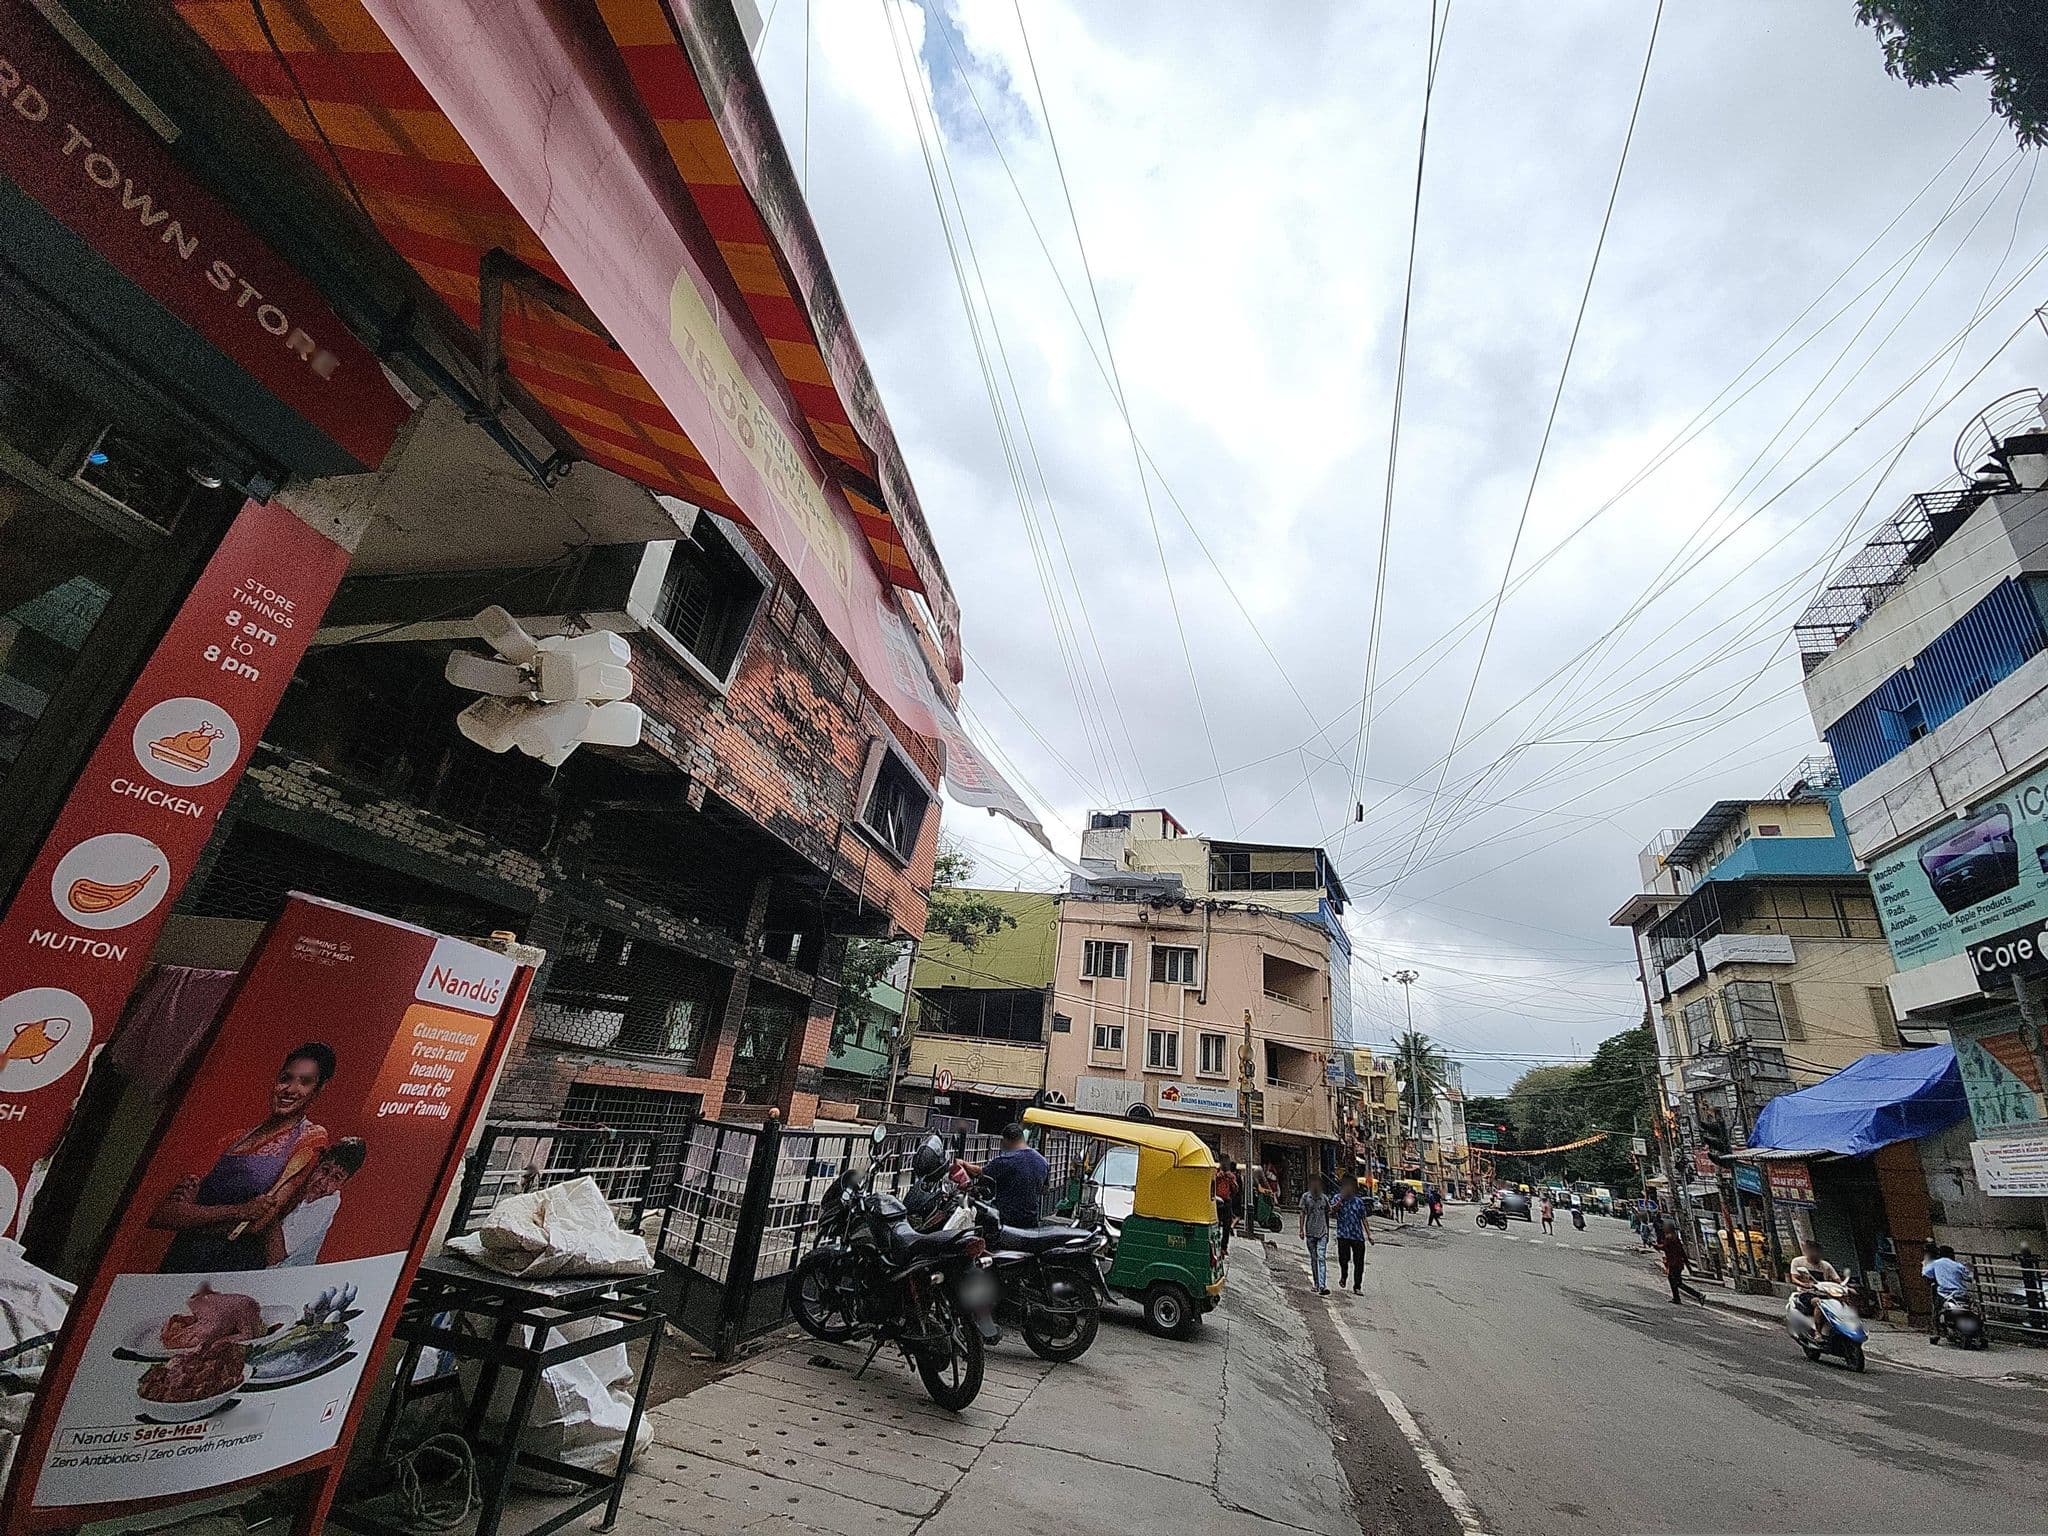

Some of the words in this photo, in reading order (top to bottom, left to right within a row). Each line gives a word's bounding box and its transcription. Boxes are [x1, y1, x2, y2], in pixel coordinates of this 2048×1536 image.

[61, 122, 199, 260] TOWN
[205, 259, 341, 382] STOR
[683, 326, 755, 449] 1800
[727, 372, 750, 410] To
[753, 413, 796, 483] Know
[757, 405, 786, 456] Call
[231, 587, 294, 629] TIMINGS
[244, 577, 297, 613] STORE
[225, 609, 243, 627] 8
[243, 622, 277, 647] am
[231, 635, 253, 656] to
[203, 644, 221, 662] 8
[221, 658, 260, 683] pm
[110, 778, 204, 819] CHICKEN
[1873, 860, 1906, 883] MacBook
[1878, 880, 1895, 894] iMac
[1882, 887, 1910, 907] iPhones
[1886, 904, 1906, 919] iPads
[1890, 915, 1918, 932] Airpods
[1894, 933, 1921, 949] Problem
[1921, 925, 1937, 939] With
[1937, 918, 1954, 932] Your
[1955, 911, 1976, 925] Apple
[1976, 895, 2012, 916] Products
[29, 929, 128, 962] MUTTON
[332, 951, 355, 962] MEAT
[1968, 939, 2034, 976] iCore
[427, 965, 500, 1004] Nandu's
[412, 1022, 479, 1047] Guaranteed
[411, 1041, 444, 1061] fresh
[446, 1046, 467, 1063] and
[409, 1060, 456, 1083] healthy
[398, 1081, 429, 1097] meat
[431, 1084, 451, 1098] for
[1181, 1097, 1198, 1105] BUILDING
[1198, 1099, 1223, 1108] MAINTENANCE
[377, 1101, 411, 1117] your
[412, 1100, 451, 1120] family
[72, 1430, 129, 1446] Nandus
[133, 1421, 208, 1441] Safe-Meat
[50, 1456, 78, 1468] Zero
[78, 1452, 140, 1467] Antibiotics
[150, 1448, 174, 1460] Zero
[176, 1441, 214, 1457] Growth
[215, 1431, 264, 1450] Promoters
